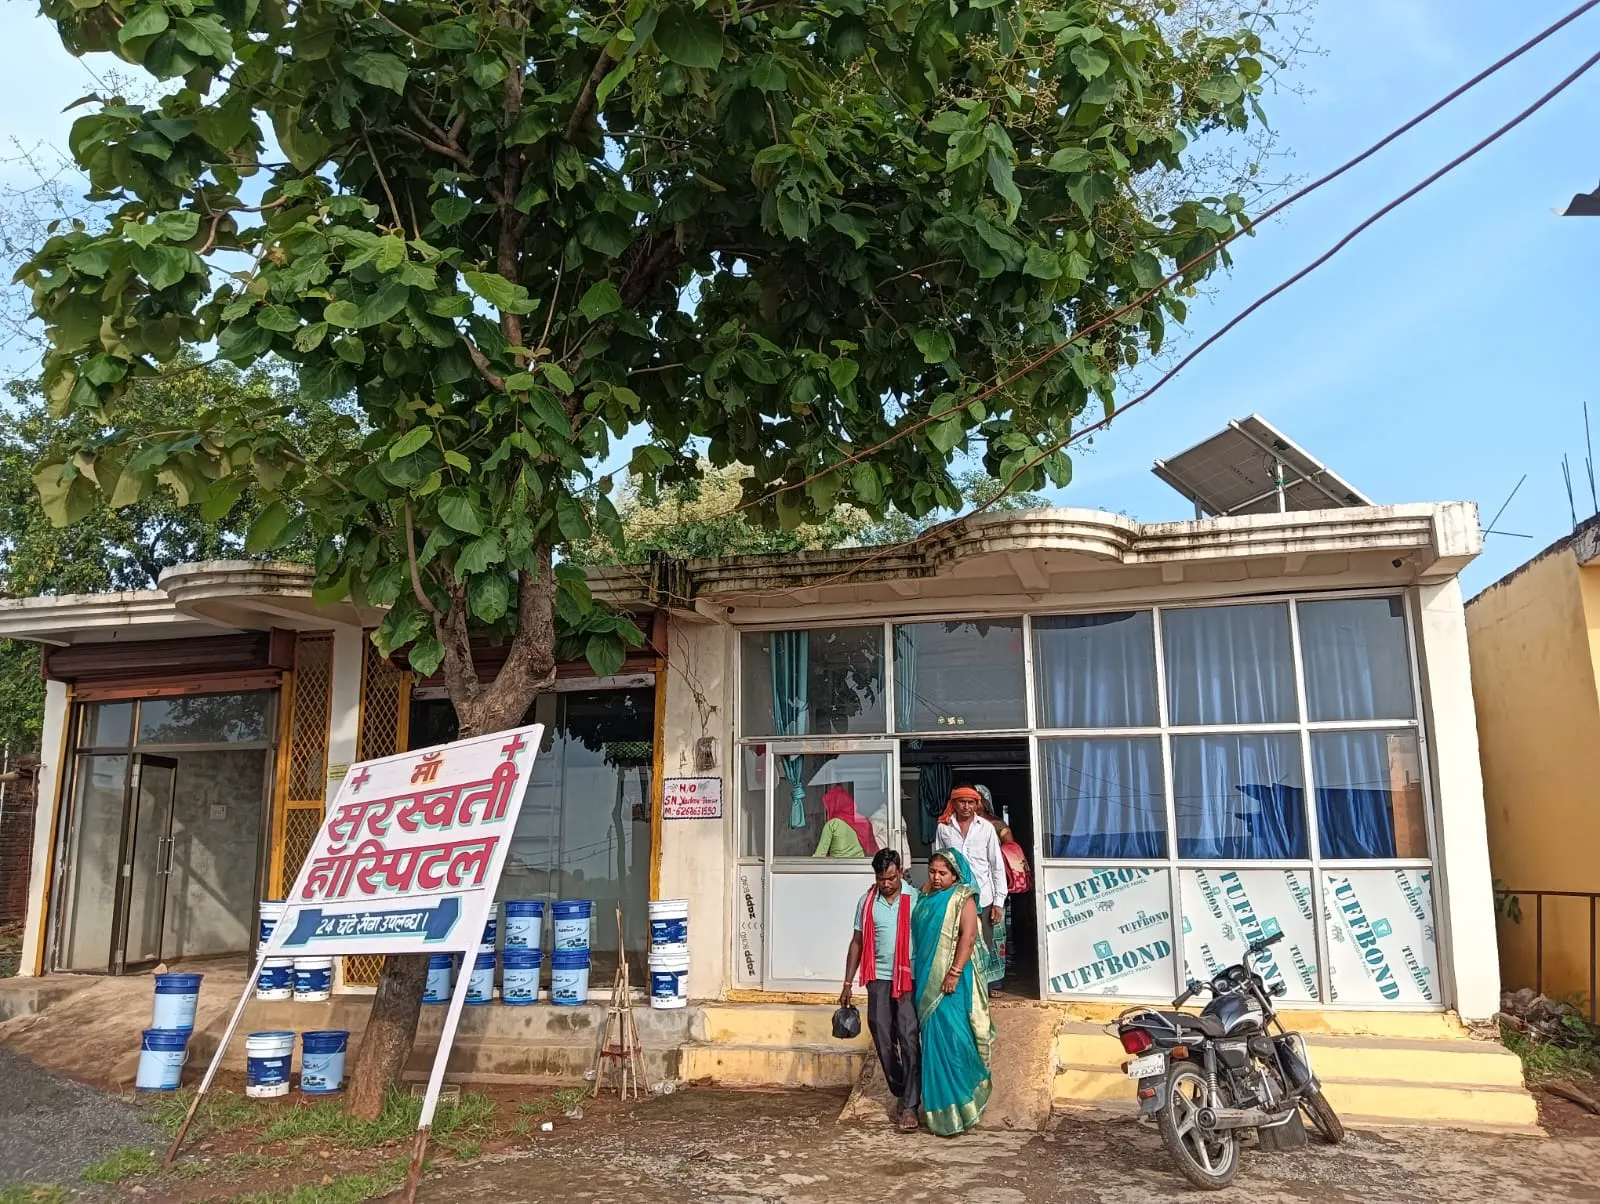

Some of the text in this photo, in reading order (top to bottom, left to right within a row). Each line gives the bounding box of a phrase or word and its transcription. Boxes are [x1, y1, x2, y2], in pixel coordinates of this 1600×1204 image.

[328, 762, 519, 841] सरस्वती
[302, 836, 500, 899] हॉस्पिटल
[1047, 868, 1161, 910] TUFFBON
[316, 919, 335, 935] 24
[1118, 911, 1169, 934] TUFFBOND
[1051, 940, 1171, 993] TUFFBOND
[1290, 944, 1319, 999] TUFFBOND
[1402, 945, 1433, 1001] TUFFBOND
